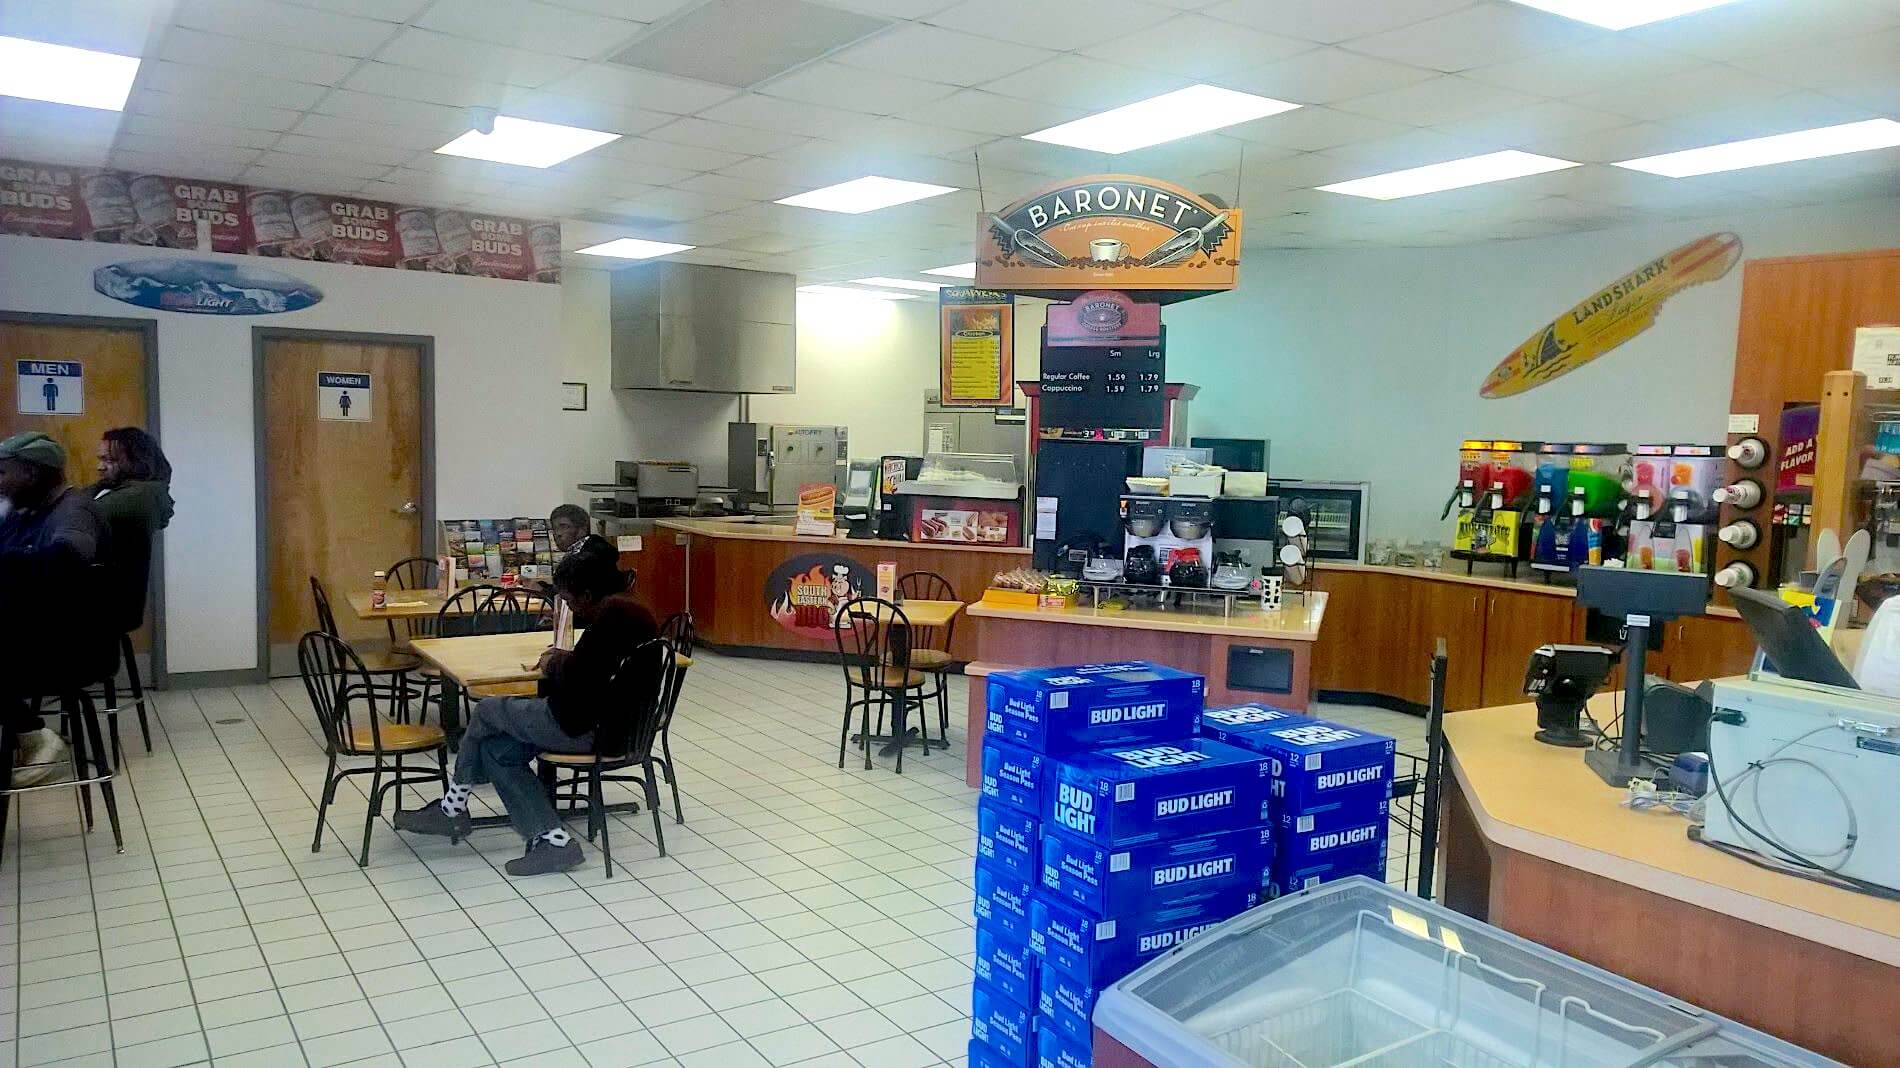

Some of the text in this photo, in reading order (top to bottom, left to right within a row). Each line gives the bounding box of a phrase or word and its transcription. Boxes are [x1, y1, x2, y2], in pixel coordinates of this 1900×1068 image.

[0, 166, 72, 186] GRAB
[0, 189, 72, 211] BUDS
[174, 184, 239, 204] GRAB
[330, 202, 389, 220] GRAB
[1028, 185, 1193, 228] BARONET
[175, 207, 239, 227] BUDS
[341, 216, 381, 228] SOME
[331, 224, 389, 242] BUDS
[469, 218, 523, 236] GRAB
[470, 239, 523, 255] BUDS
[1572, 257, 1668, 325] LANDSHARK
[196, 297, 235, 308] LIGHT
[1084, 301, 1121, 312] BARONET
[1148, 350, 1160, 359] Lrg
[31, 362, 70, 376] MEN
[1042, 373, 1159, 381] Regular Coffee 1.59 1.79
[325, 376, 361, 386] WOMEN
[1041, 385, 1159, 393] Cappuccino 1.59 1.79
[1785, 438, 1813, 457] ADD A
[1780, 451, 1814, 471] FLAVOR
[797, 585, 827, 596] SOUTH
[1005, 705, 1039, 723] Season Pass
[1009, 698, 1035, 713] Bud Light
[1091, 703, 1165, 724] BUD LIGHT
[1203, 706, 1265, 719] BUD
[989, 711, 1003, 723] BUD
[1213, 710, 1290, 726] LIGHT
[987, 720, 1004, 734] LIGHT
[1269, 725, 1337, 739] BUD
[1218, 731, 1227, 741] 12
[1283, 729, 1363, 747] LIGHT
[1112, 746, 1184, 761] BUD
[1385, 741, 1394, 750] 12
[1123, 751, 1213, 768] LIGHT
[1289, 752, 1300, 763] 12
[1004, 762, 1031, 779] Bud Light
[1258, 761, 1268, 772] 18
[984, 774, 998, 787] BUD
[999, 769, 1034, 789] Season Pass
[1317, 765, 1384, 790] BUD LIGHT
[982, 782, 999, 798] LIGHT
[1100, 781, 1109, 792] 18
[1058, 782, 1093, 813] BUD
[1157, 790, 1233, 817] BUD LIGHT
[1379, 801, 1387, 810] 12
[1054, 802, 1096, 835] LIGHT
[1260, 829, 1270, 839] 18
[1310, 826, 1377, 852] BUD LIGHT
[1045, 864, 1059, 880] BUD
[1065, 854, 1094, 875] Bud Light
[1153, 858, 1233, 885] BUD LIGHT
[1043, 872, 1061, 890] LIGHT
[1061, 861, 1098, 886] Season Pass
[1247, 893, 1257, 903] 18
[1031, 928, 1045, 945] BUD
[1052, 920, 1080, 942] Bud Light
[1029, 937, 1047, 955] LIGHT
[1047, 927, 1084, 954] Season Pass
[1140, 932, 1174, 952] BUD
